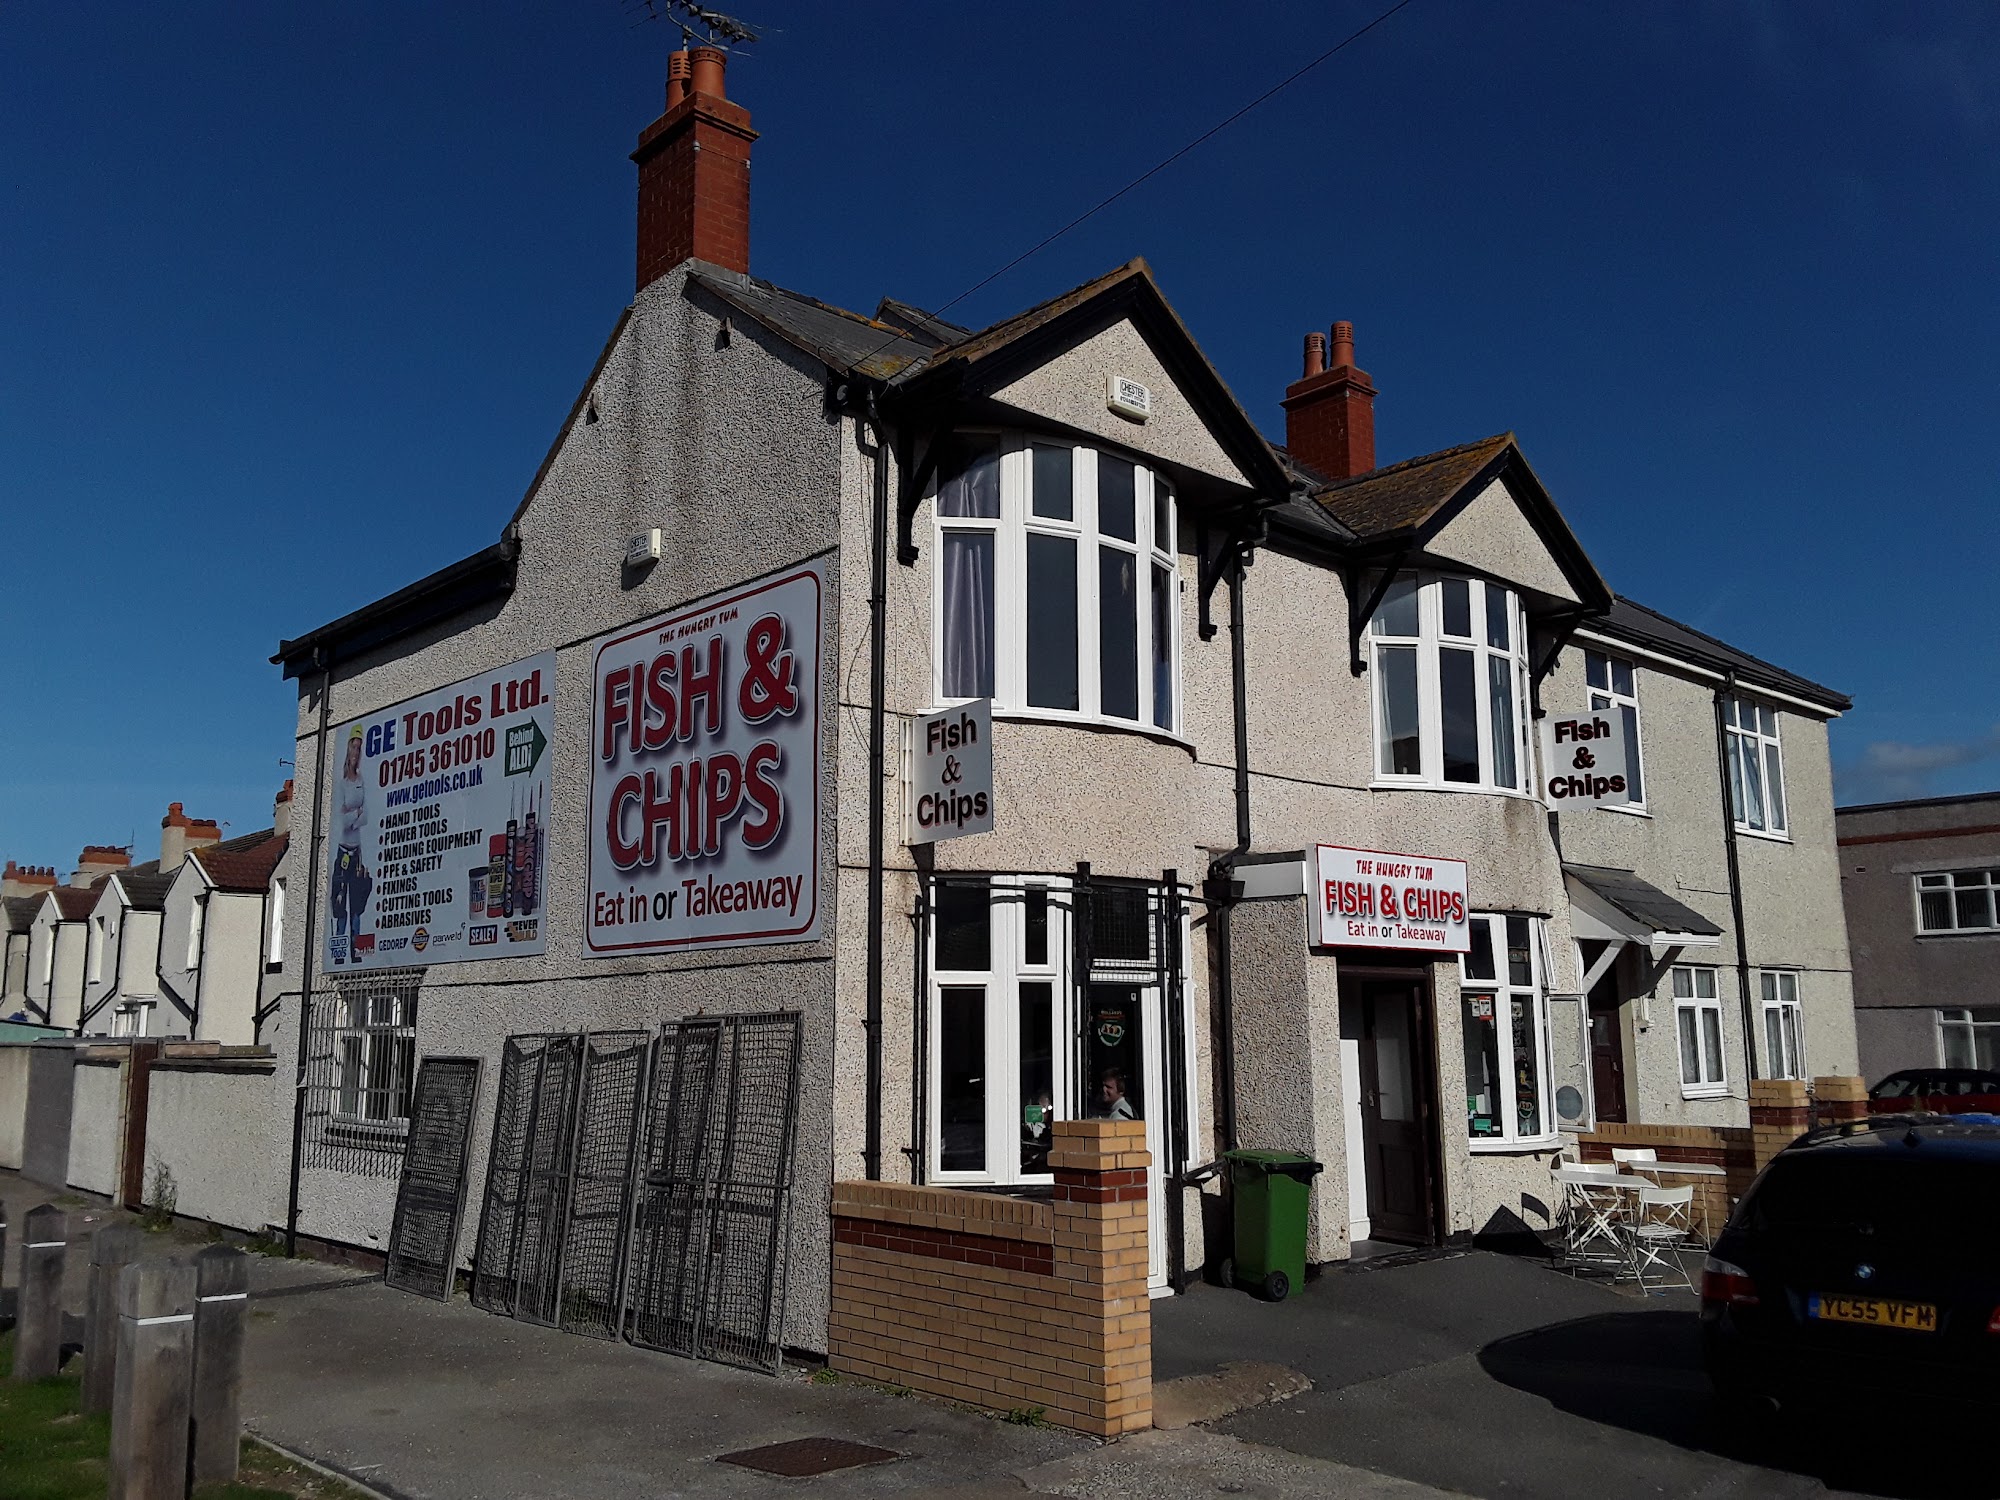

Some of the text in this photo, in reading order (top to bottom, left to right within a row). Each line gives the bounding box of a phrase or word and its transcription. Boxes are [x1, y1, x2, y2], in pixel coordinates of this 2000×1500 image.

[659, 607, 739, 645] THE HUNGRY TUM
[602, 612, 798, 761] FISH &
[365, 669, 549, 757] GE Tools Ltd.
[509, 726, 534, 748] Behind
[927, 712, 977, 755] Fish
[1554, 716, 1610, 743] Fish
[379, 728, 495, 787] 01745 361010
[941, 755, 962, 786] &
[1572, 746, 1595, 769] &
[386, 764, 483, 808] www.getools.co.uk
[1549, 773, 1626, 800] Chips
[386, 803, 440, 829] HAND TOOLS
[607, 741, 783, 869] CHIPS
[917, 789, 988, 829] Chips
[384, 819, 448, 845] POWER TOOLS
[384, 829, 482, 862] WELDING EQUIPMENT
[383, 854, 443, 879] PPE & SAFETY
[1356, 860, 1433, 881] THE HUNGRY TUM
[382, 876, 417, 895] FIXINGS
[382, 893, 420, 912] CUTTING
[422, 888, 453, 907] TOOLS
[594, 873, 803, 927] Eat in or Takeaway
[1325, 879, 1464, 922] FISH & CHIPS
[381, 909, 431, 929] ABRASIVES
[518, 919, 538, 930] EVER
[433, 932, 462, 946] parweld
[471, 927, 496, 943] SEALEY
[1347, 921, 1446, 944] Eat in or Takeaway
[1823, 1298, 1879, 1321] YC55
